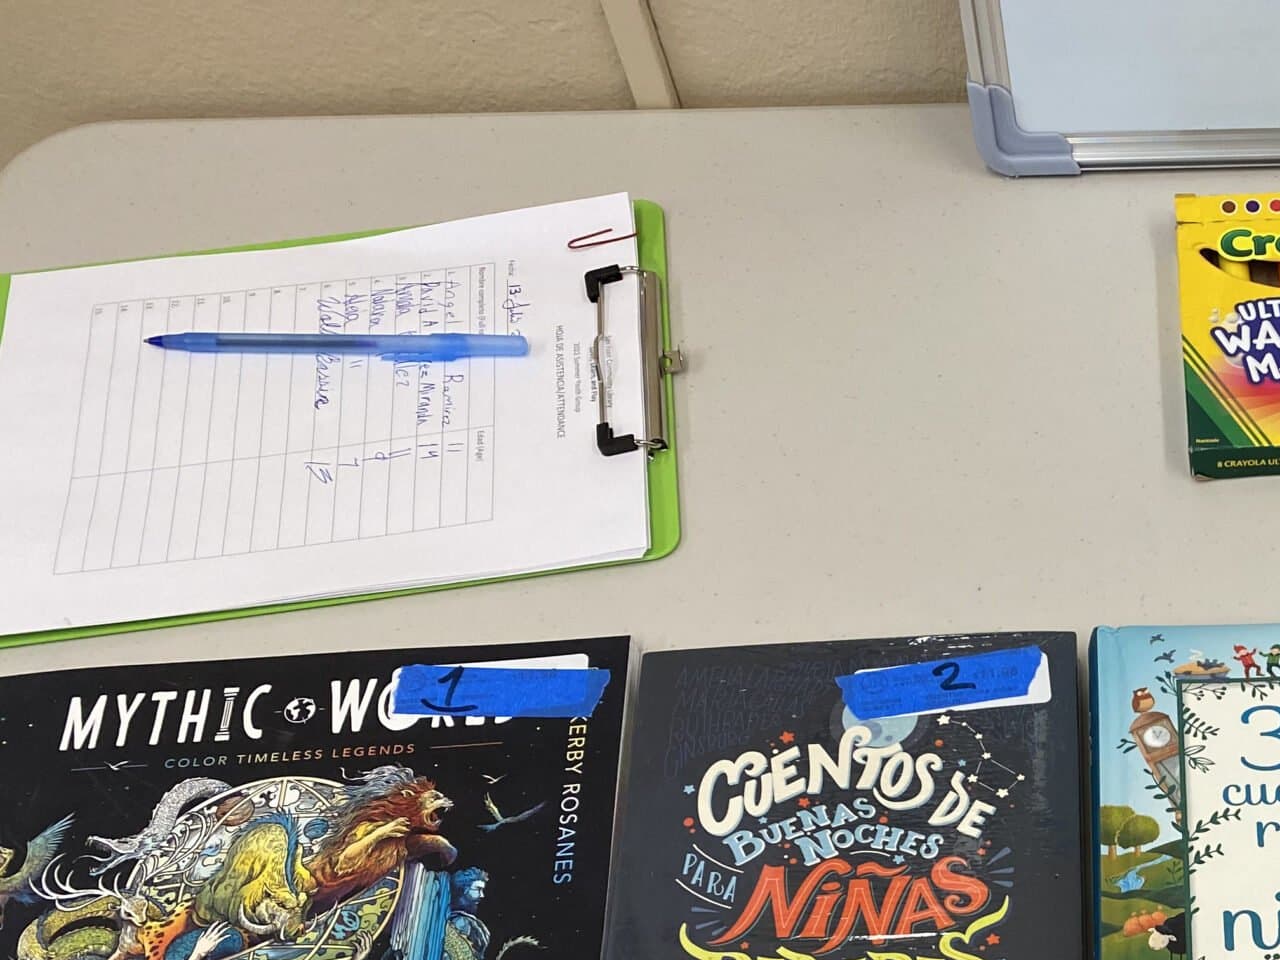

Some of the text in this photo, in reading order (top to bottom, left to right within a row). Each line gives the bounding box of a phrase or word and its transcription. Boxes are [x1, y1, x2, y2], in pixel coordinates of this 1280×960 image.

[1224, 459, 1266, 469] CRAYOLA
[931, 662, 977, 692] 2
[59, 683, 273, 752] MYTHIC
[164, 743, 416, 770] COLOR TIMELESS LEGENDS
[697, 726, 944, 838] CUENTOS
[927, 770, 998, 840] DE
[552, 783, 582, 885] ROSANES
[722, 797, 877, 867] BUENAS
[795, 823, 944, 867] NOCHES
[681, 852, 738, 904] PARA
